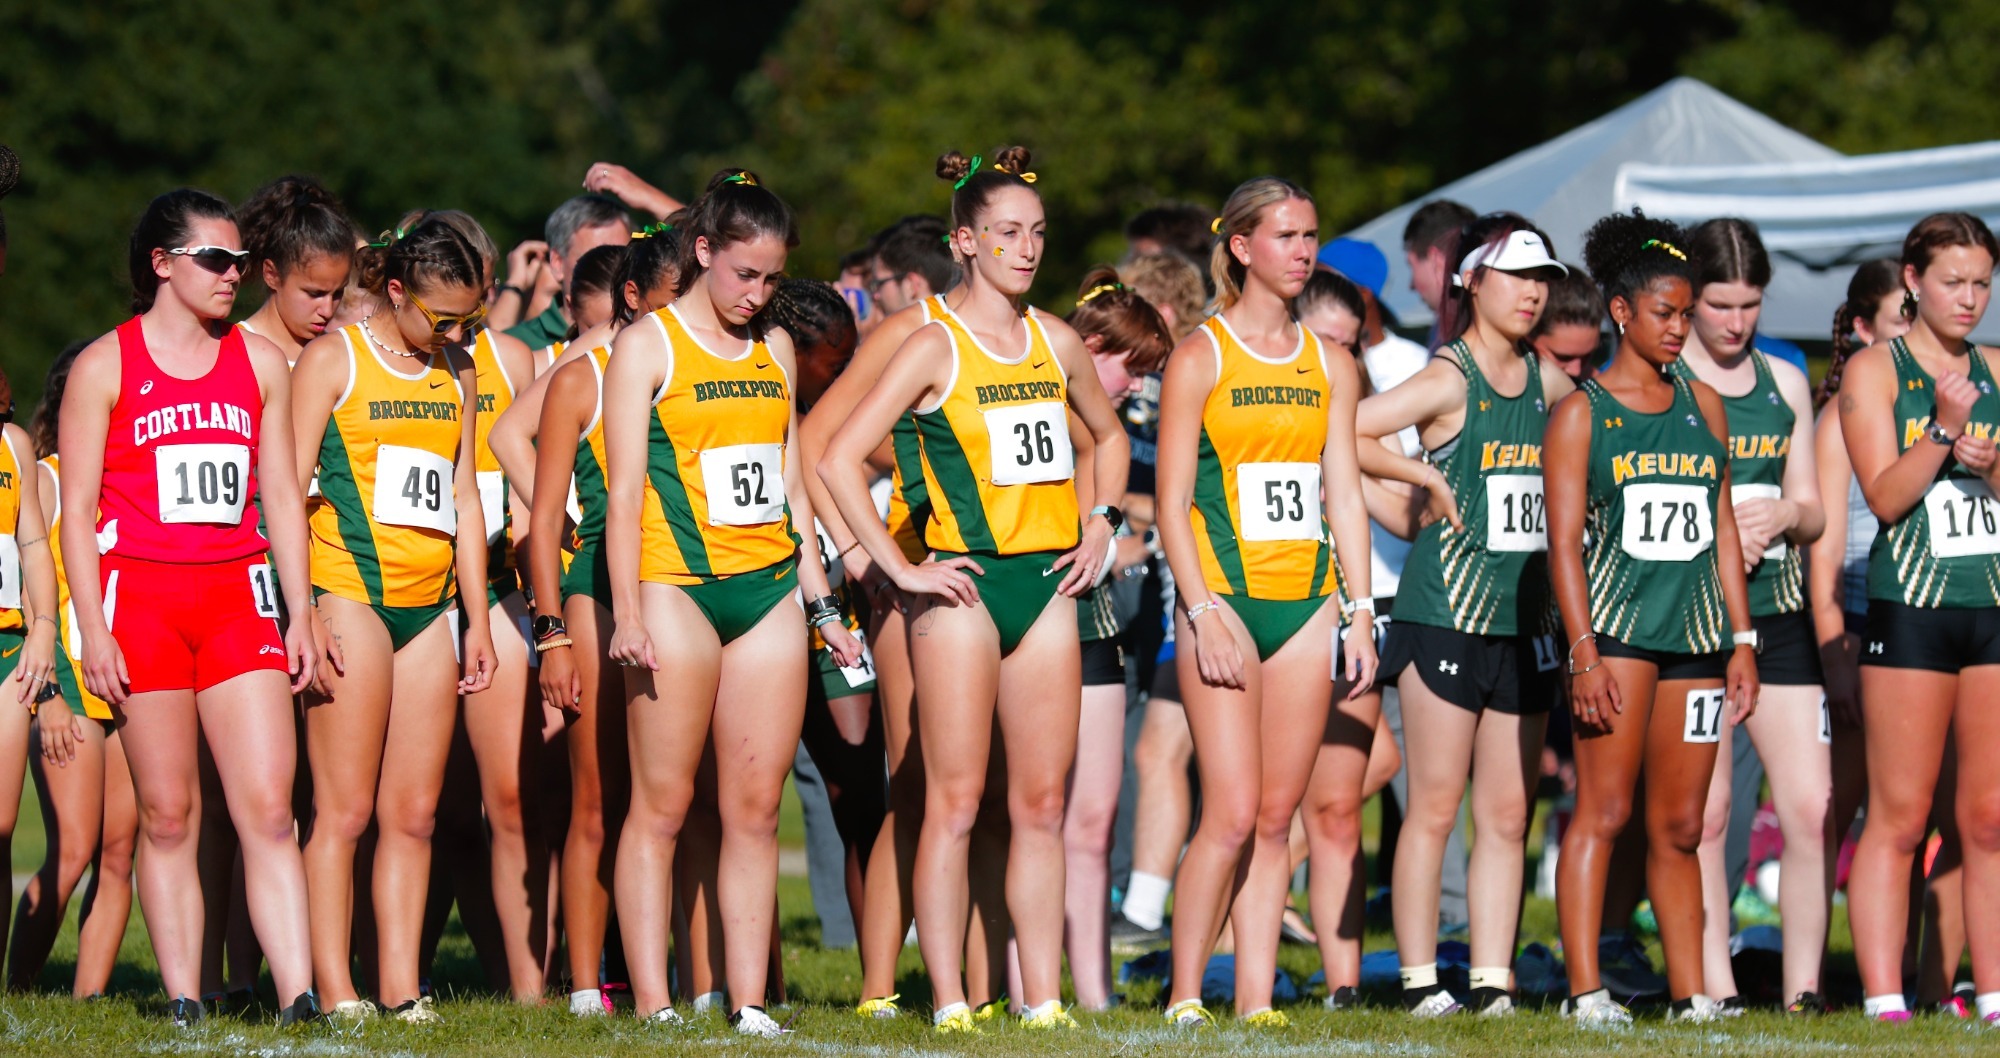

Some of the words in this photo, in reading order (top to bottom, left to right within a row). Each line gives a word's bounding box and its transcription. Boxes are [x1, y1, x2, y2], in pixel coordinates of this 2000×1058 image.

[368, 400, 458, 421] BROCKPORT
[692, 380, 786, 402] BROCKPORT
[975, 380, 1061, 405] BROCKPORT
[1231, 386, 1321, 409] BROCKPORT
[134, 402, 252, 446] CORTLAND
[1013, 420, 1054, 466] 36
[1480, 440, 1543, 471] KEUK
[1611, 450, 1717, 486] KEUKA
[174, 461, 239, 506] 109
[401, 466, 441, 512] 49
[730, 461, 769, 507] 52
[1264, 480, 1304, 522] 53
[1503, 493, 1545, 533] 182
[1639, 502, 1700, 543] 178
[1943, 495, 1997, 538] 176
[255, 569, 274, 613] 1
